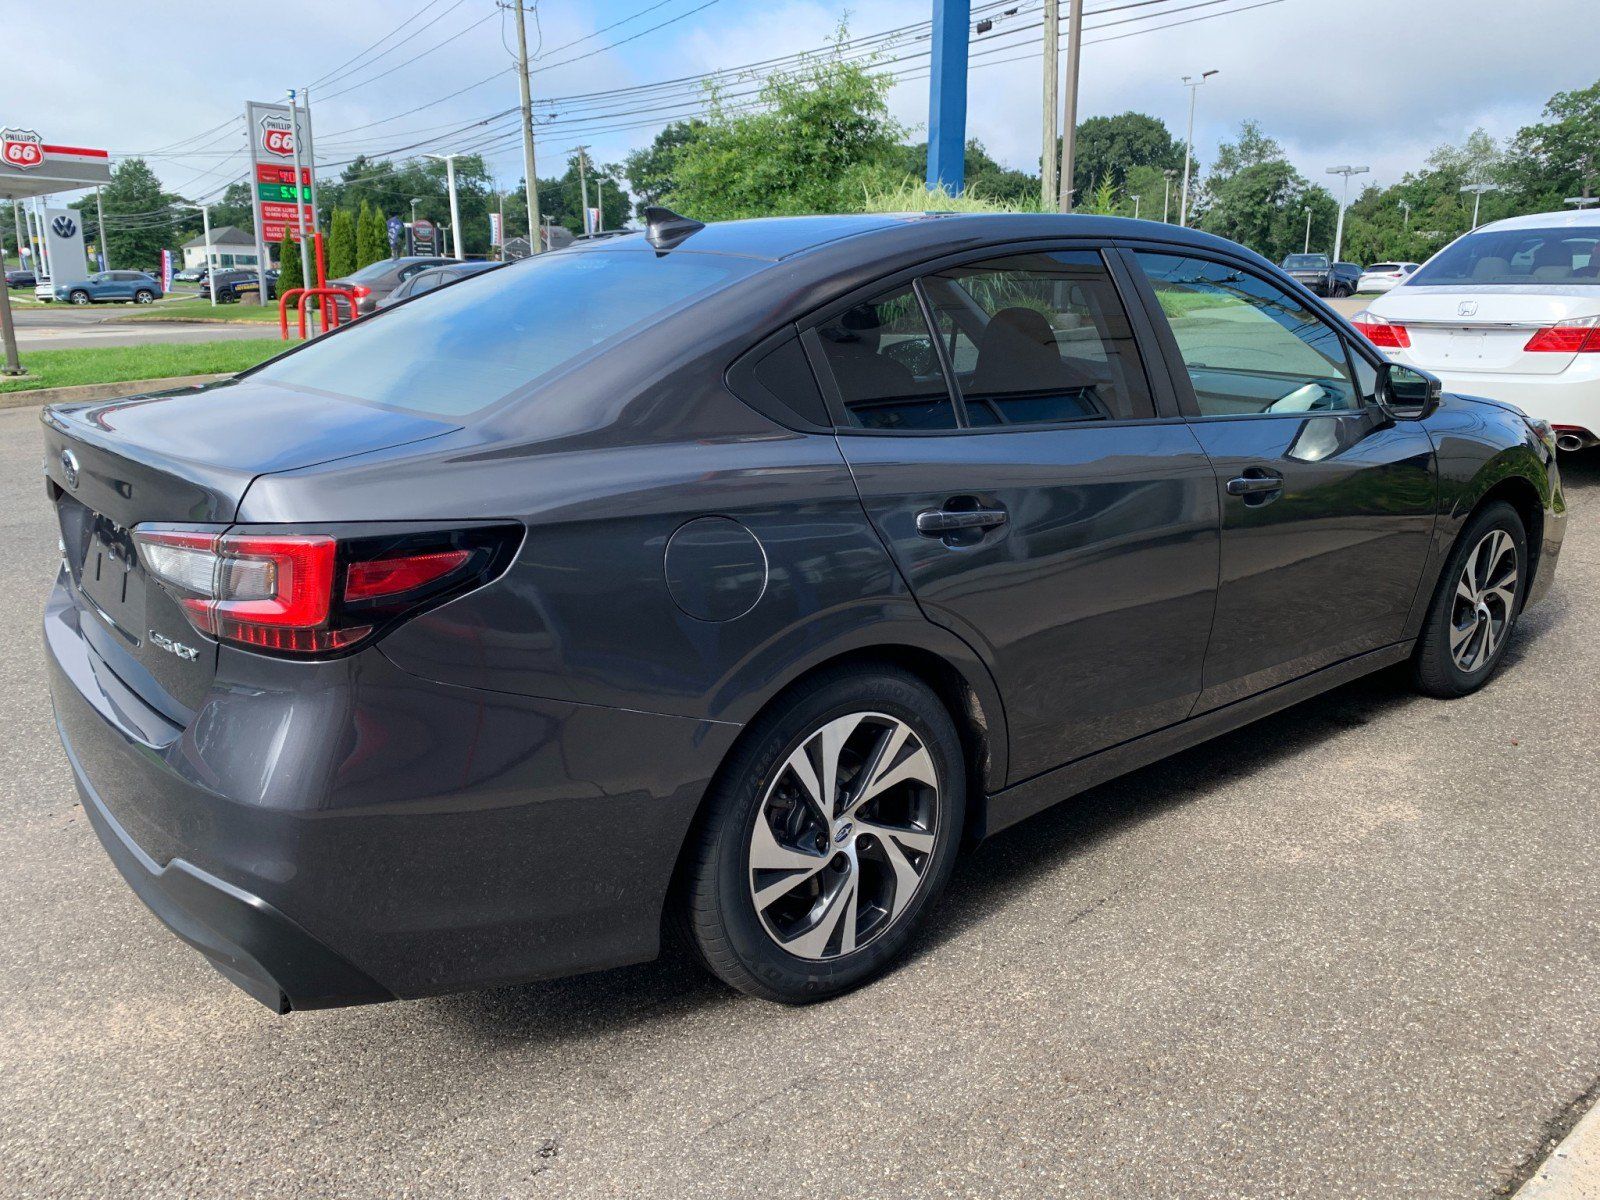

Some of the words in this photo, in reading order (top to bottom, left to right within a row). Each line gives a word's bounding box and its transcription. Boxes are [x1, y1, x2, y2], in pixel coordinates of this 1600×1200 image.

[266, 121, 292, 130] PHILLIP
[5, 133, 36, 142] PHILLIPS
[270, 132, 295, 150] 66
[9, 144, 36, 160] 66
